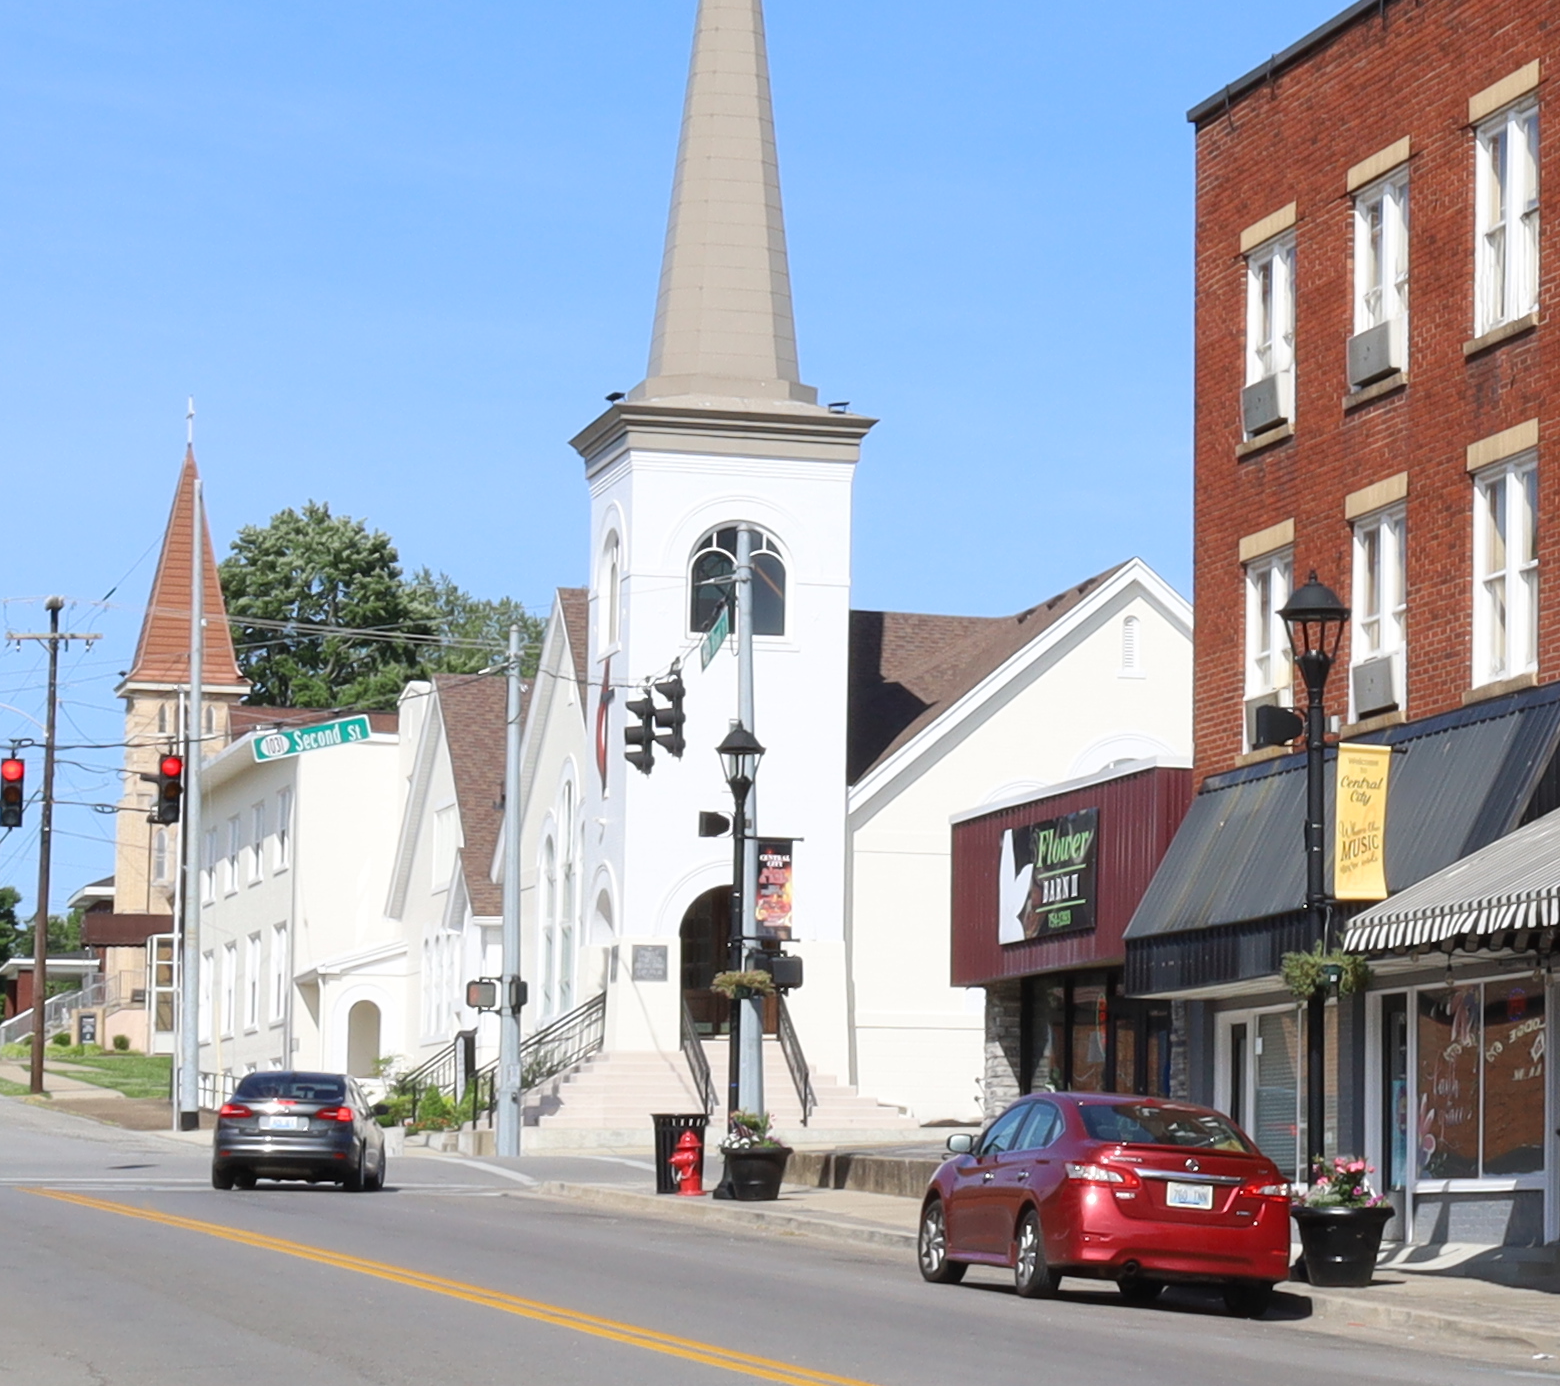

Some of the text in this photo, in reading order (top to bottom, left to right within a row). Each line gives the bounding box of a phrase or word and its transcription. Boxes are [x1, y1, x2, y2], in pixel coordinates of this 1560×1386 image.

[293, 723, 342, 752] Second
[347, 724, 362, 742] St
[1340, 774, 1384, 790] Central
[1350, 789, 1371, 807] City
[1036, 828, 1091, 869] Flower
[1340, 833, 1380, 863] MUSIC
